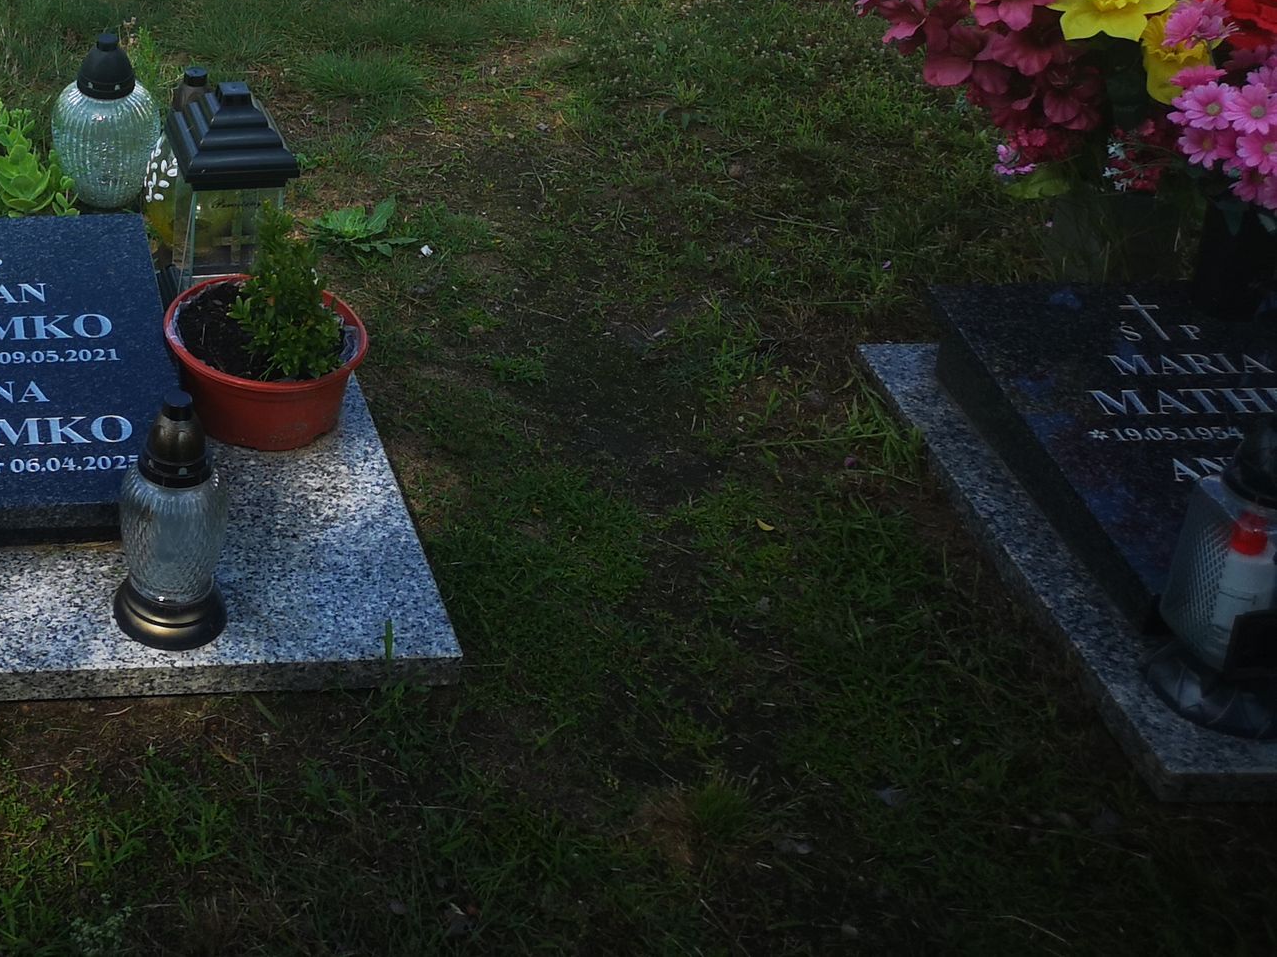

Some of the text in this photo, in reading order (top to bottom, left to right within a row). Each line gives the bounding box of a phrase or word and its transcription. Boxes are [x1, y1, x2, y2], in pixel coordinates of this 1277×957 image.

[1104, 353, 1275, 376] MARIA
[1086, 387, 1277, 416] MATH
[1172, 456, 1234, 482] AN
